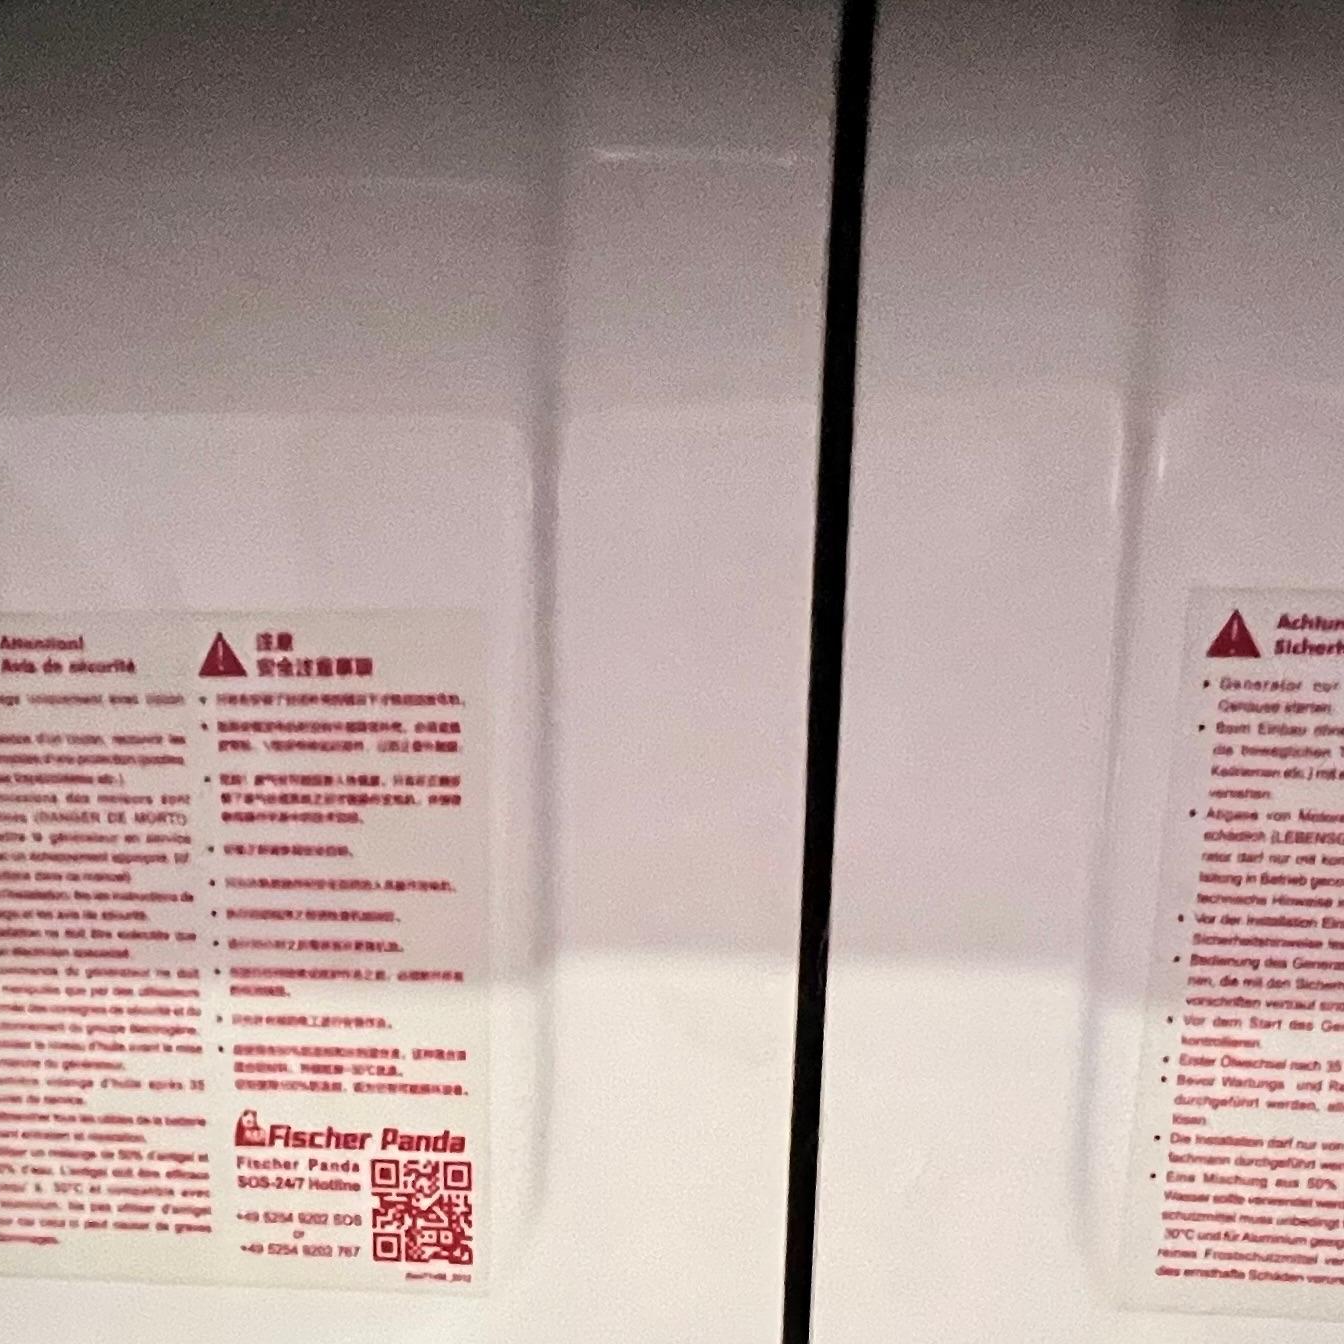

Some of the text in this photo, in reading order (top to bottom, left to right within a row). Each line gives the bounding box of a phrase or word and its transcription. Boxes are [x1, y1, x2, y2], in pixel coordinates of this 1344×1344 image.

[267, 1124, 466, 1154] Fischer Panda
[236, 1155, 360, 1173] Fischer Panda
[237, 1175, 361, 1192] SOS-24/7 Hotline
